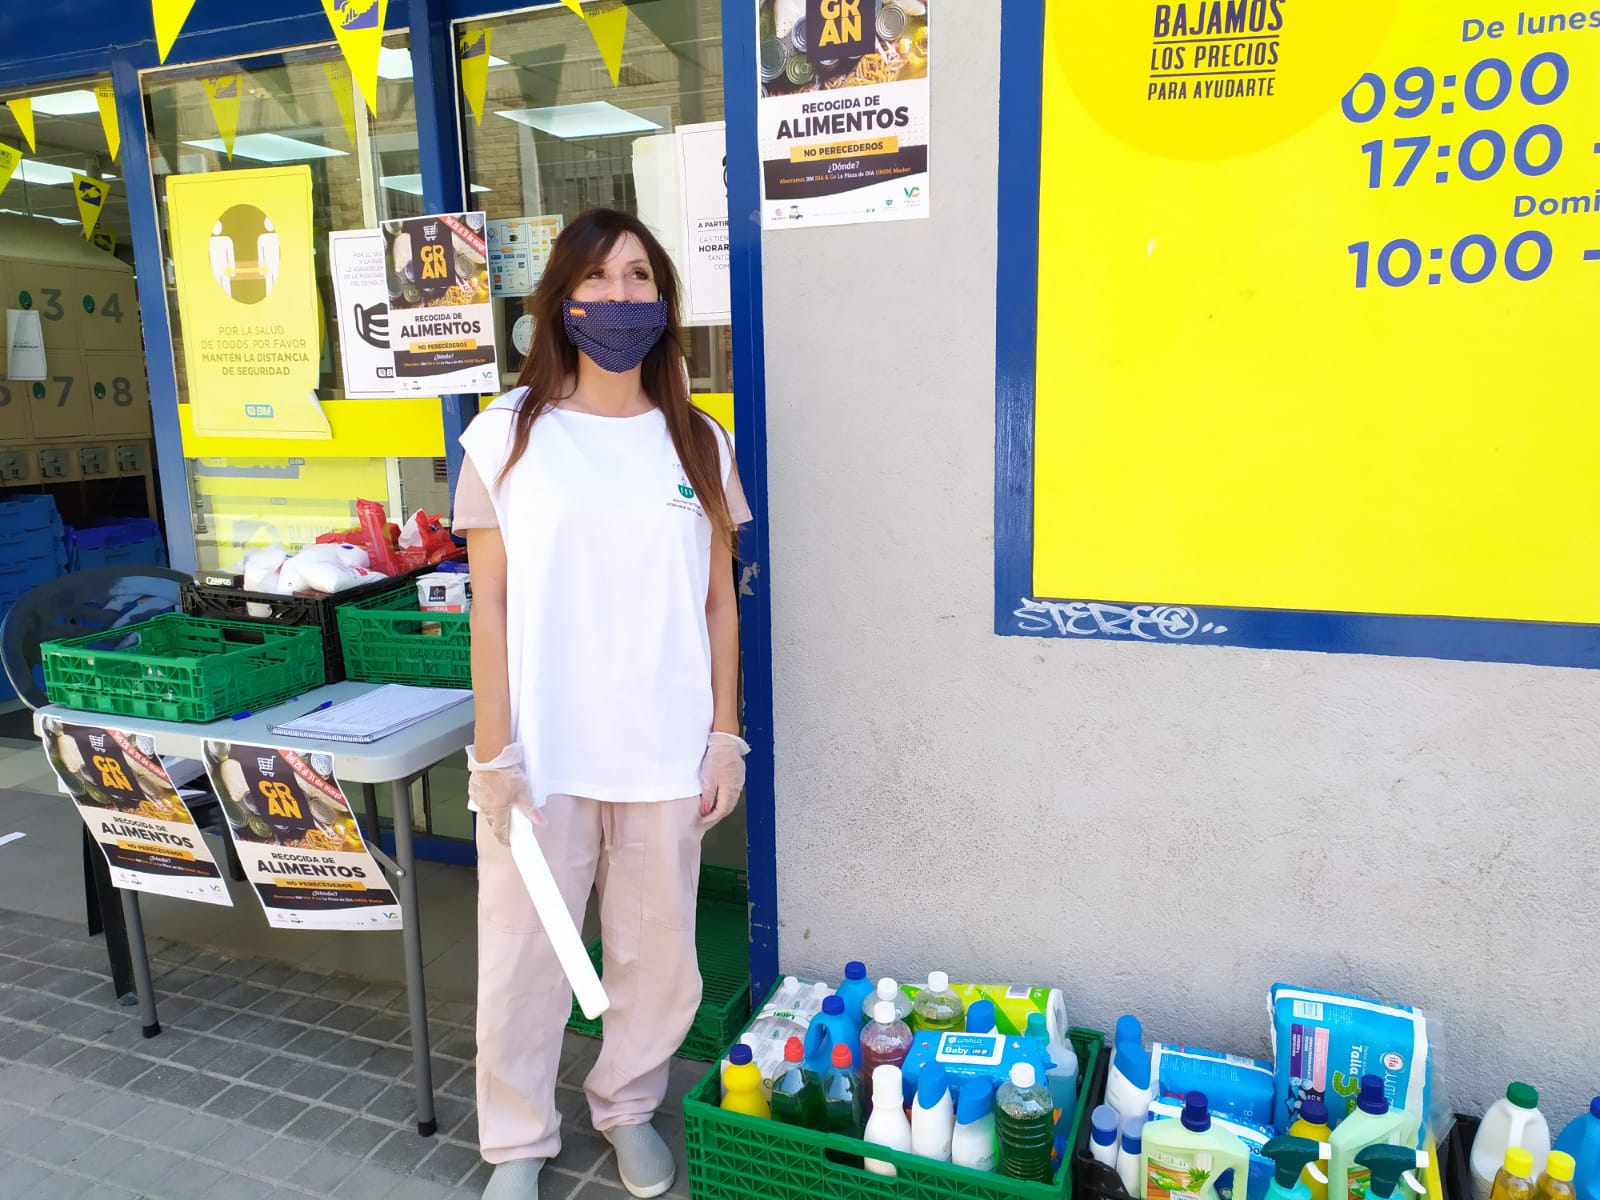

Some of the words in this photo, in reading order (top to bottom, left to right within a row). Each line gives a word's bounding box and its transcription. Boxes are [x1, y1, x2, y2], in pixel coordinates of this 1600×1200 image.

[1153, 0, 1285, 38] BAJAMOS
[1462, 18, 1503, 42] De
[1517, 9, 1600, 37] lunes
[819, 15, 862, 47] AN
[1151, 46, 1185, 71] LOS
[1193, 40, 1280, 68] PRECIOS
[1147, 80, 1188, 101] PARA
[1193, 77, 1276, 99] AYUDARTE
[1341, 51, 1570, 124] 09:00
[802, 97, 860, 115] RECOGIDA
[865, 95, 880, 106] DE
[776, 106, 909, 140] ALIMENTOS
[804, 147, 817, 158] NO
[819, 142, 884, 156] PERECEDEROS
[1361, 123, 1564, 189] 17:00
[827, 160, 860, 173] ¿Dónde?
[420, 244, 445, 263] GR
[1347, 230, 1554, 289] 10:00
[422, 261, 447, 279] AN
[41, 289, 64, 321] 3
[102, 294, 124, 323] 4
[415, 314, 451, 322] RECOGIDA
[219, 326, 238, 336] POR
[241, 326, 252, 335] LA
[254, 325, 285, 335] SALUD
[401, 321, 481, 338] ALIMENTOS
[201, 341, 213, 349] DE
[254, 340, 271, 348] POR
[273, 339, 306, 348] FAVOR
[244, 353, 255, 361] LA
[257, 353, 310, 362] DISTANCIA
[222, 367, 235, 375] DE
[237, 367, 290, 376] SEGURIDAD
[53, 376, 74, 407] 7
[112, 377, 133, 407] 8
[102, 773, 134, 792] AN
[258, 780, 292, 801] GR
[268, 797, 302, 819] AN
[113, 816, 154, 830] RECOGIDA
[102, 822, 194, 849] ALIMENTOS
[271, 852, 320, 864] RECOGIDA
[321, 856, 336, 864] DE
[257, 860, 367, 879] ALIMENTOS
[945, 1046, 968, 1055] Baby
[1350, 1045, 1363, 1075] Talla
[1388, 1055, 1399, 1068] ifa
